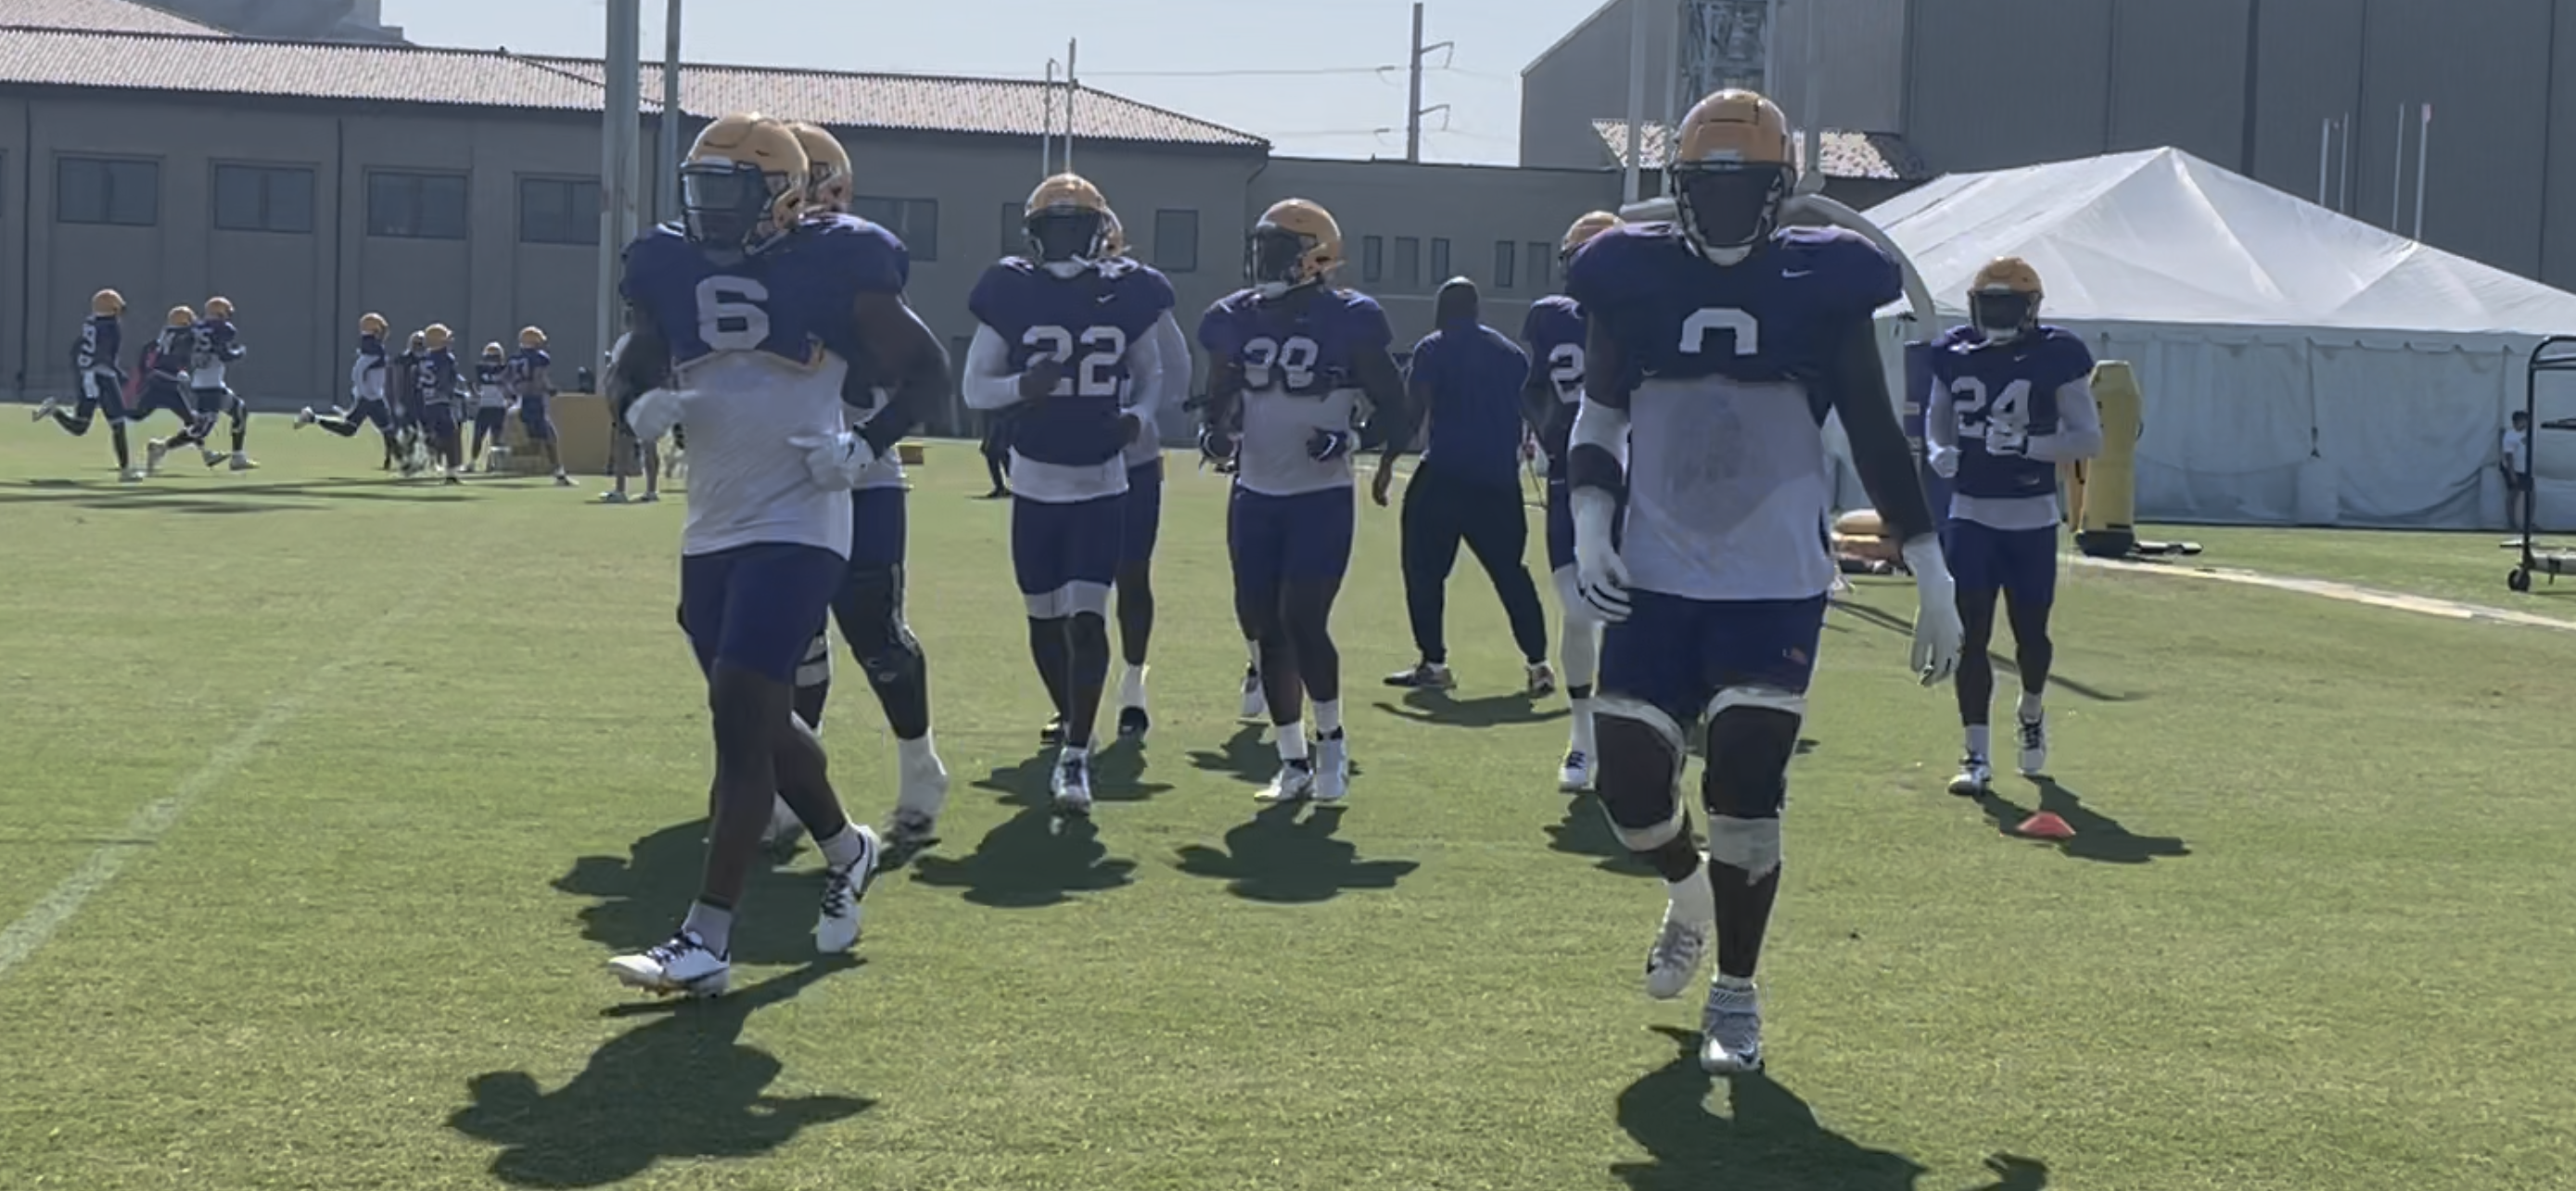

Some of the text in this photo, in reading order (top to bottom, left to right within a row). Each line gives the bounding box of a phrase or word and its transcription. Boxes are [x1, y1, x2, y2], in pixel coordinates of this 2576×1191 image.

[695, 275, 769, 351] 6
[1023, 325, 1125, 396] 22
[1951, 376, 2031, 437] 24
